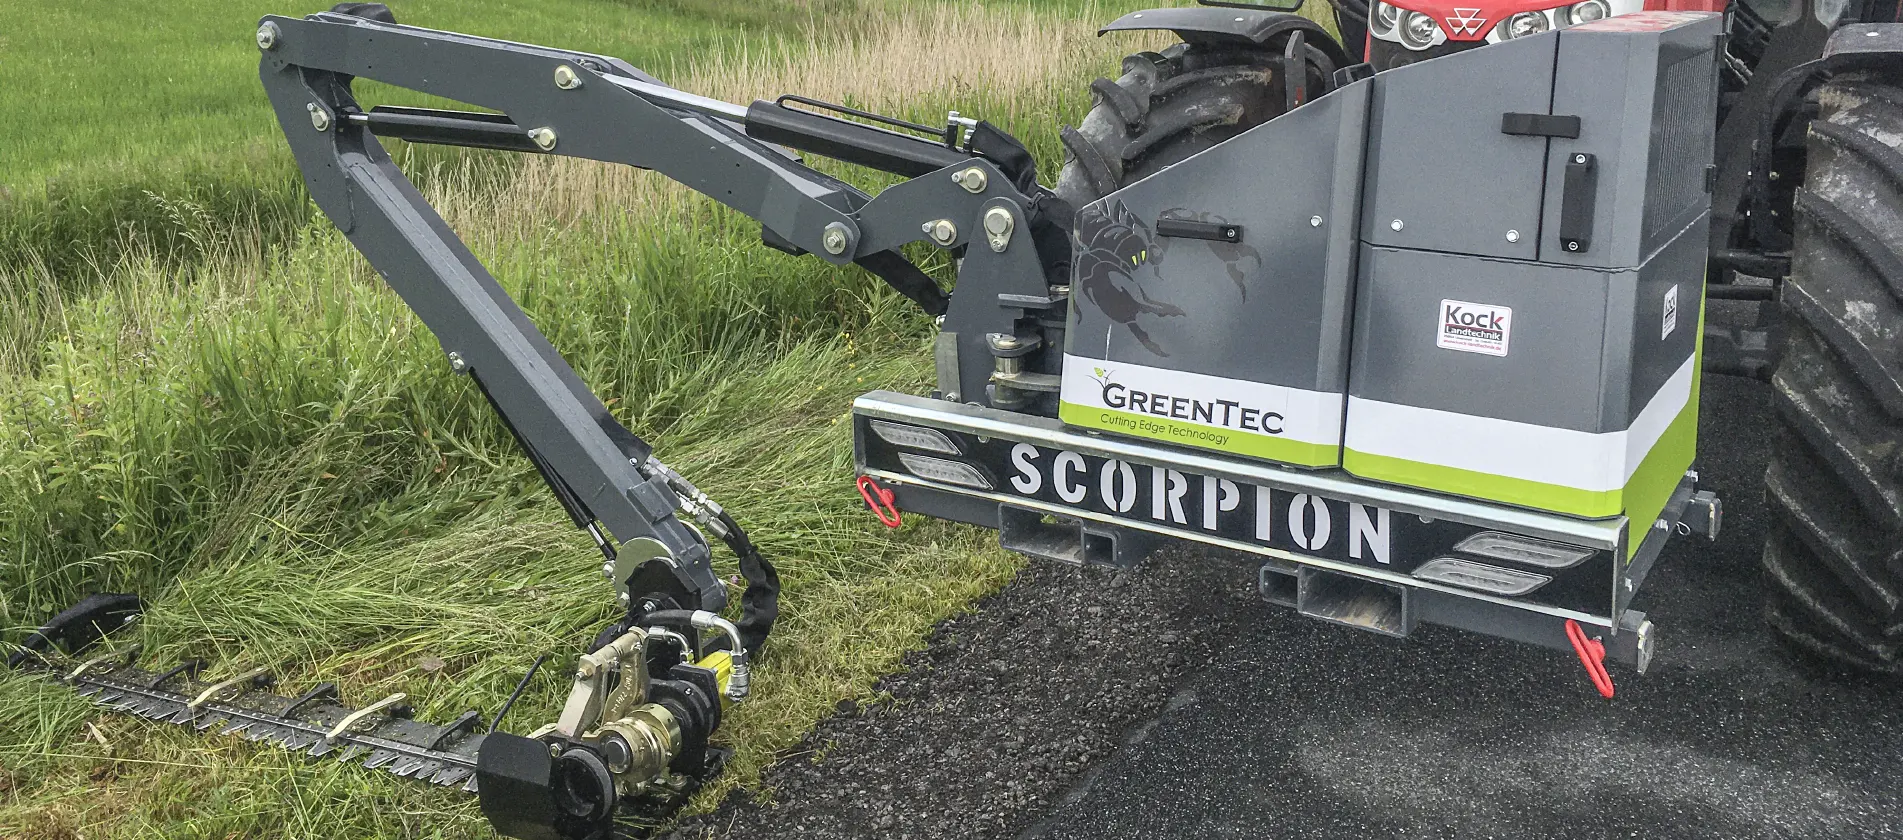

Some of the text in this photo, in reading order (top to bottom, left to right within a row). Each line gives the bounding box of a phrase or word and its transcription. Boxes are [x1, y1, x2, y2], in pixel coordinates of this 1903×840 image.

[1446, 305, 1504, 330] Kock
[1446, 327, 1501, 341] Landtechnik
[1100, 413, 1230, 445] Cutting Edge Technology
[1010, 443, 1390, 564] SCORPION
